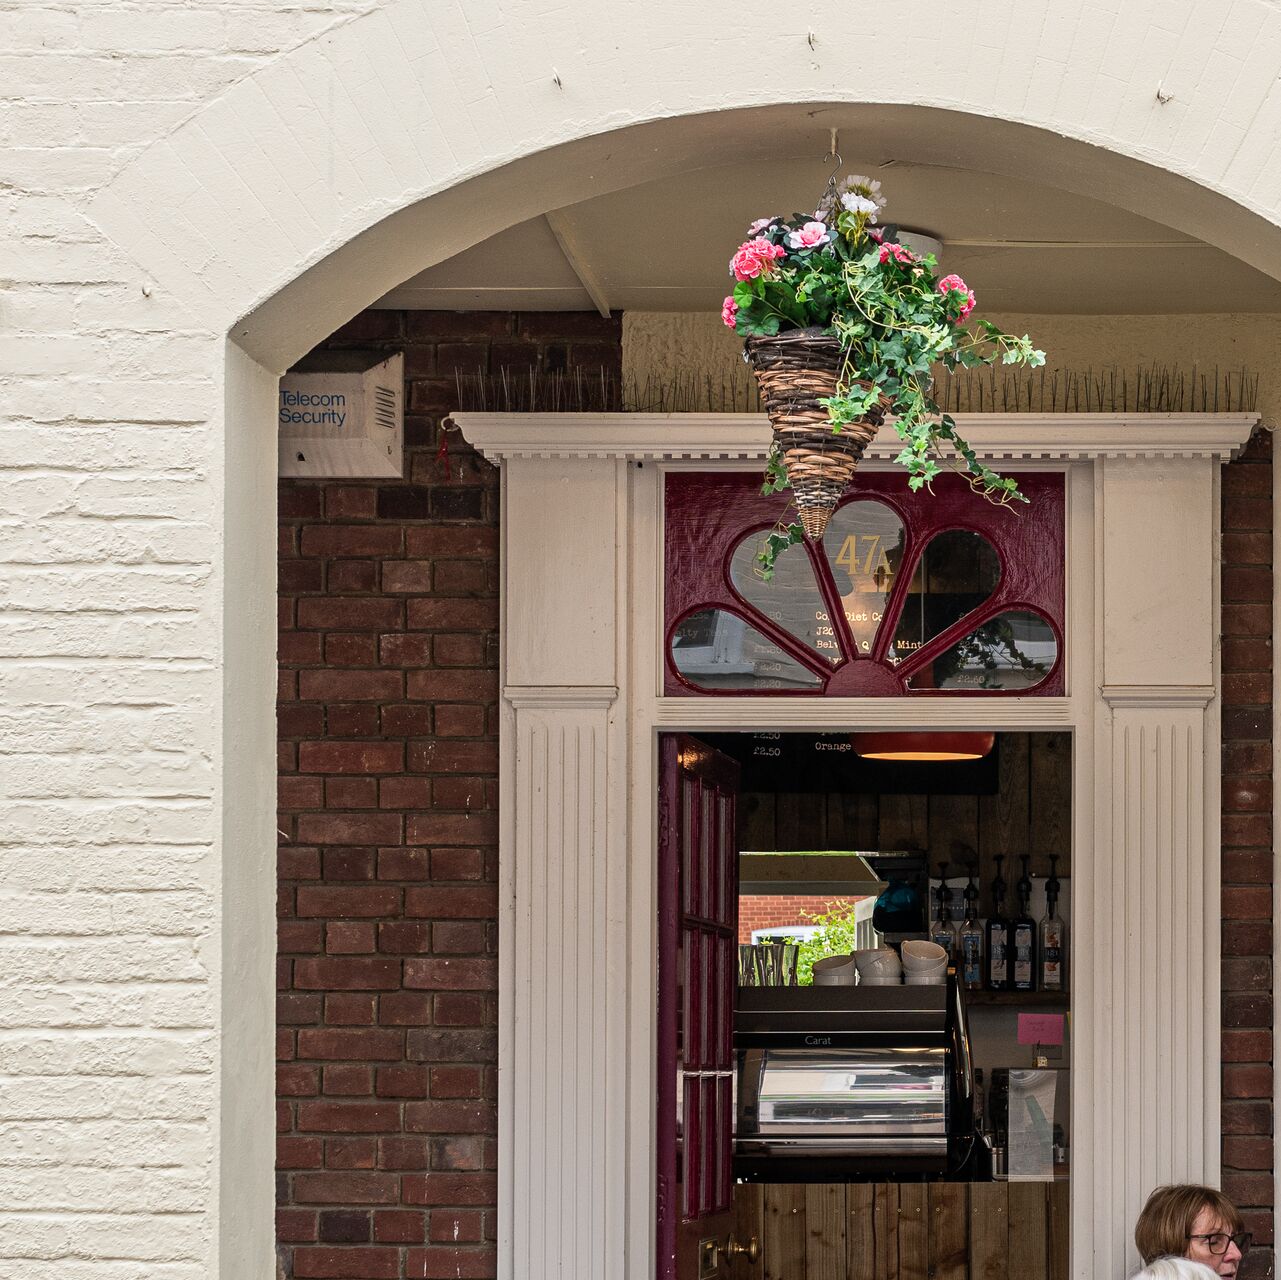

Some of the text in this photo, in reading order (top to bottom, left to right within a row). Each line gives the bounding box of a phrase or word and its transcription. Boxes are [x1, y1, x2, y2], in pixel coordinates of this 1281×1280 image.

[280, 391, 345, 406] Telecom
[280, 408, 346, 427] Security
[835, 535, 895, 575] 47A
[897, 640, 922, 649] Mint
[753, 746, 781, 756] £2.50
[815, 741, 852, 752] Orange
[804, 1035, 832, 1045] Carat
